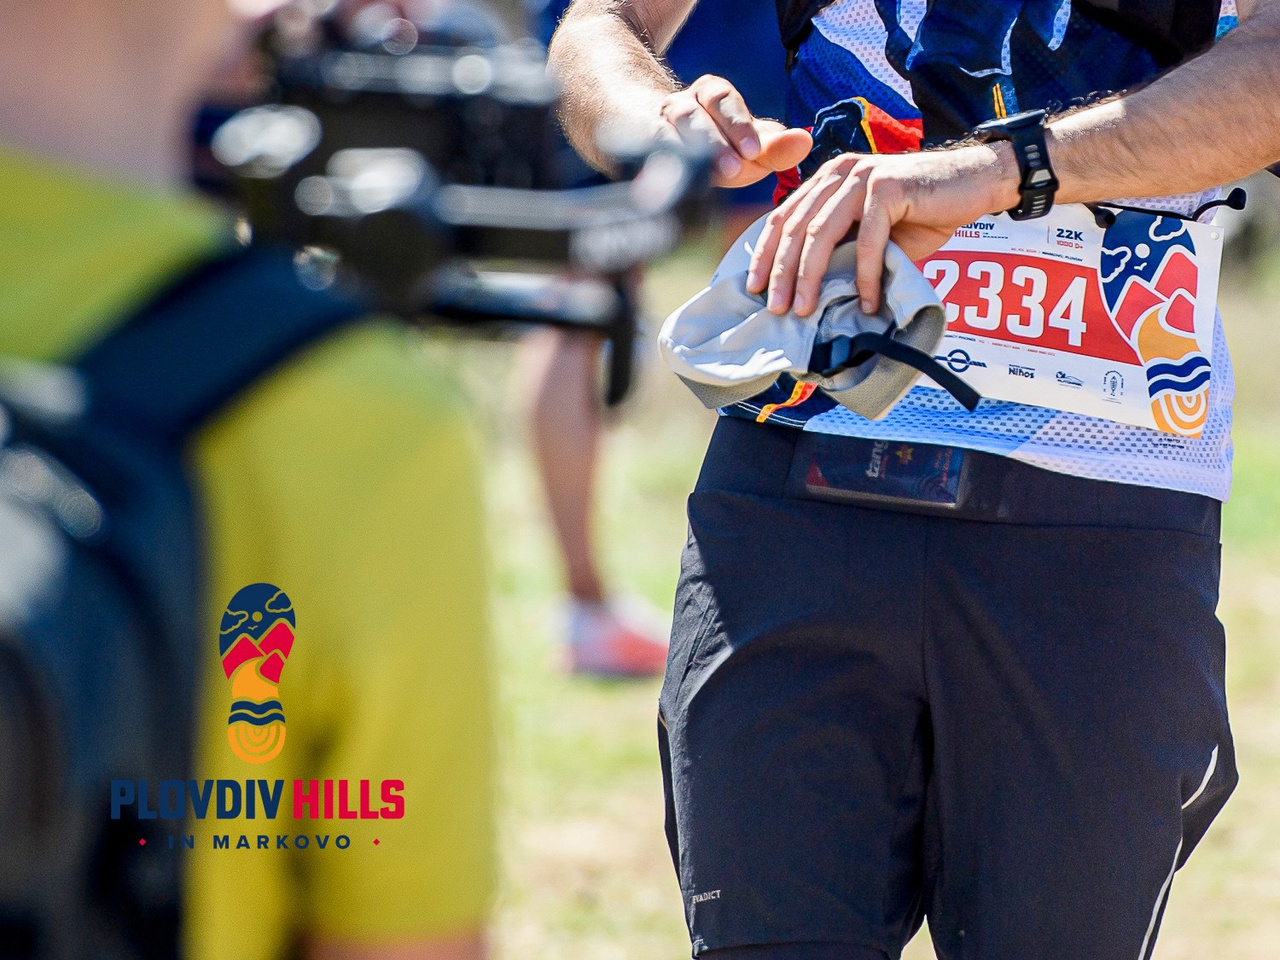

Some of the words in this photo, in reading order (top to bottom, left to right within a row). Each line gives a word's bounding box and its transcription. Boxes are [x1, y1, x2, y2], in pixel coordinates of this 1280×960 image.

[954, 229, 980, 238] HILLS
[1056, 228, 1084, 241] 22K
[922, 258, 1088, 347] 2334
